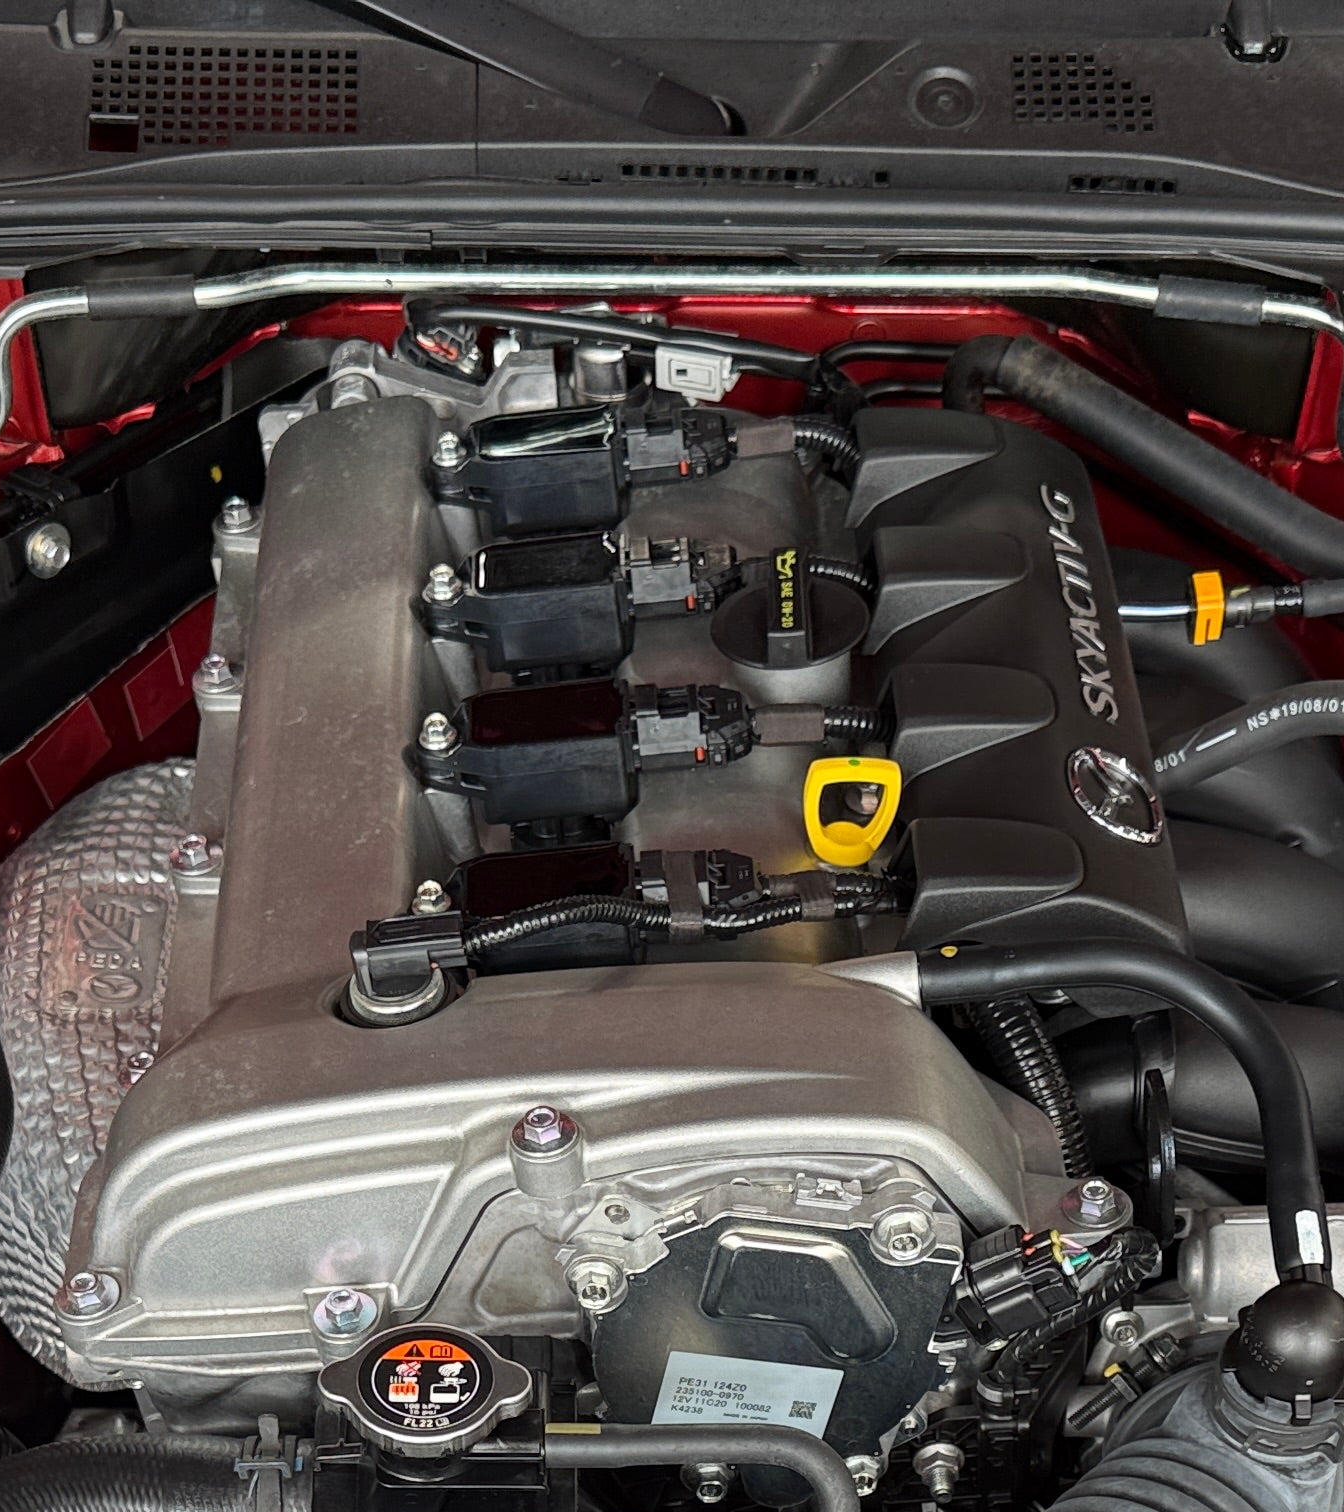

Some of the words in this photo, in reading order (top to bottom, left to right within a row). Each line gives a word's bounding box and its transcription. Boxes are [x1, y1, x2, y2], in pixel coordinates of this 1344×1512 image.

[780, 581, 794, 598] SAE
[1041, 484, 1118, 725] SKYACTIV-G
[679, 1377, 707, 1387] PE31
[404, 1418, 433, 1427] FL22
